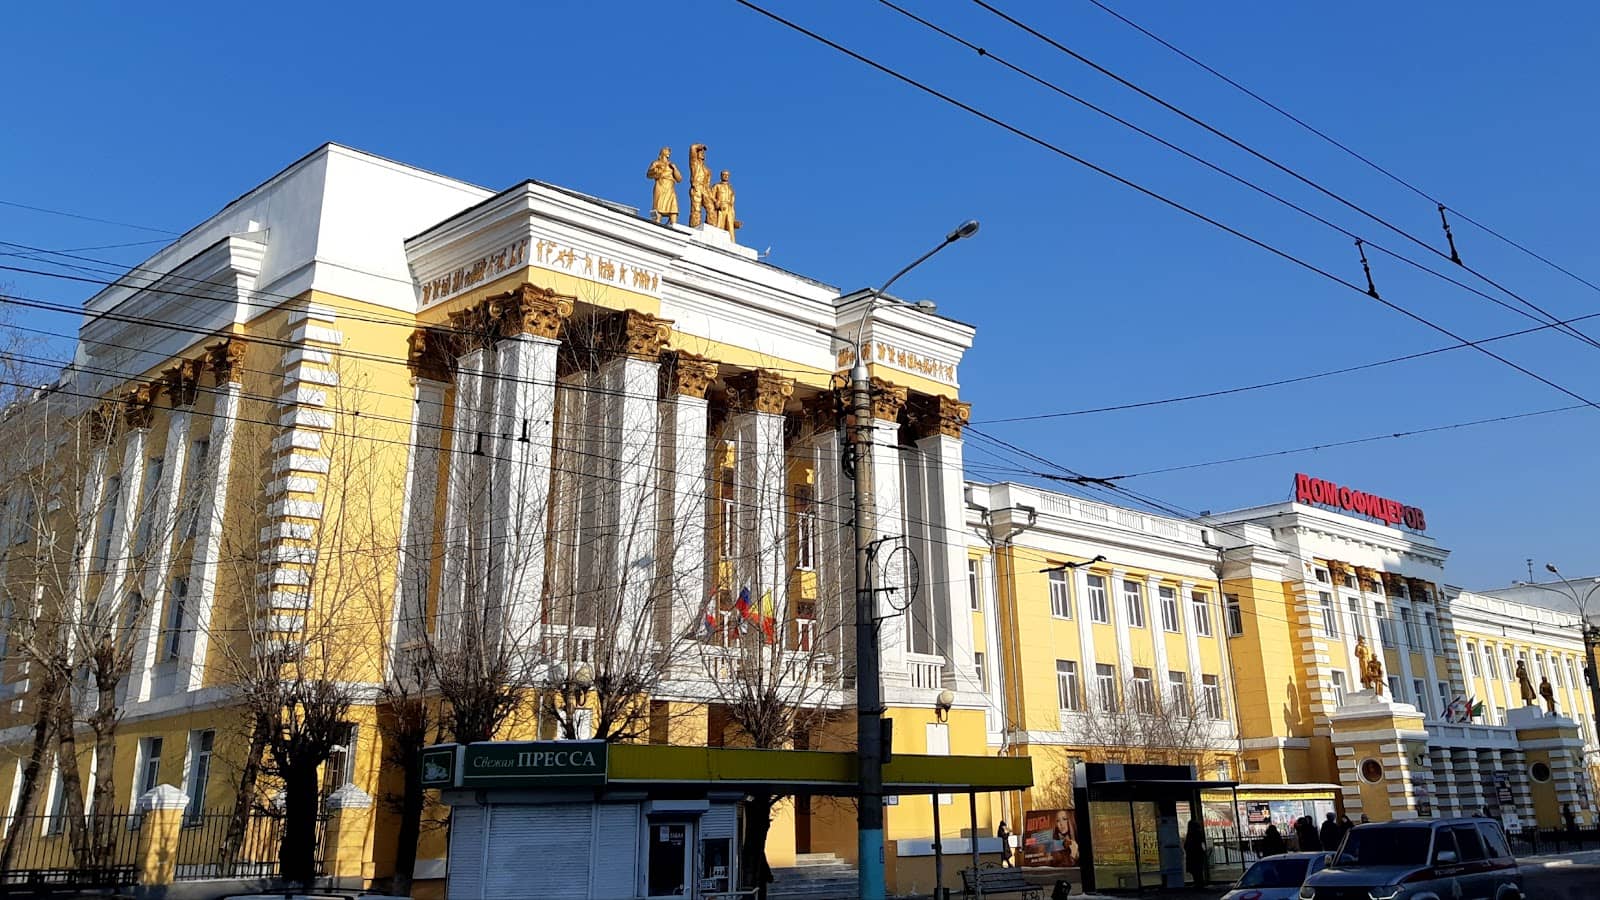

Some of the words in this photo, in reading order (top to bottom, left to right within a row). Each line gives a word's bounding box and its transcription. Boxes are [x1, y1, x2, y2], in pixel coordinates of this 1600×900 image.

[1295, 473, 1340, 507] ДОМ
[1340, 486, 1426, 530] ОФИЦЕРОВ
[473, 756, 514, 768] Свежая
[517, 751, 596, 768] ПРЕССА
